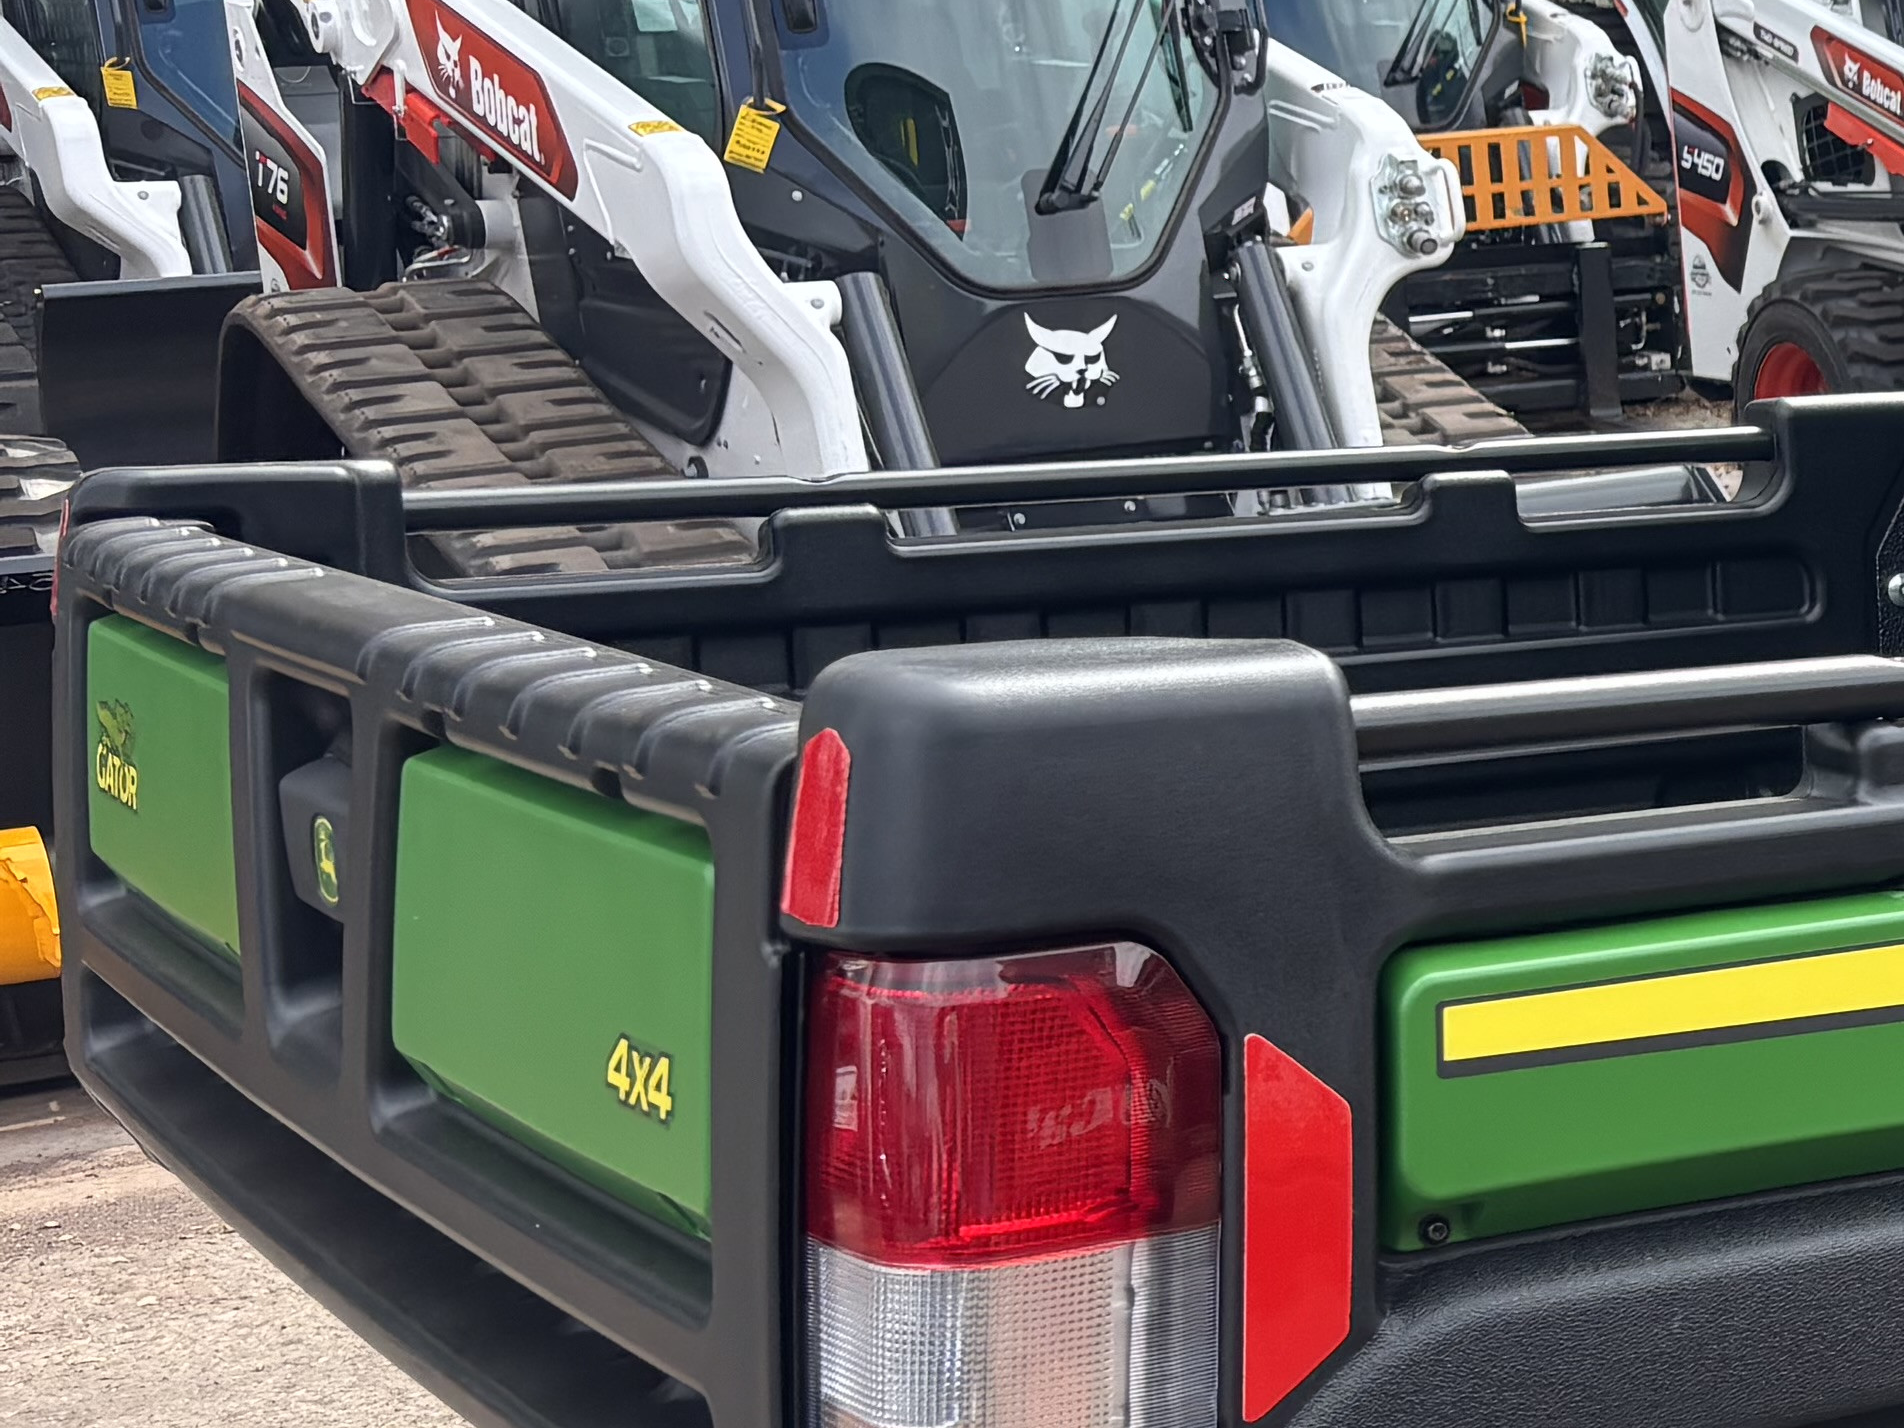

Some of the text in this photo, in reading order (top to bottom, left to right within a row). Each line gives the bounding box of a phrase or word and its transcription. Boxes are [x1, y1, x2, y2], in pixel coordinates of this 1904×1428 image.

[469, 54, 542, 166] Bobcat
[1862, 70, 1903, 114] Bobcat
[255, 149, 291, 206] T76
[1680, 144, 1726, 182] S450
[97, 741, 138, 811] GATOR
